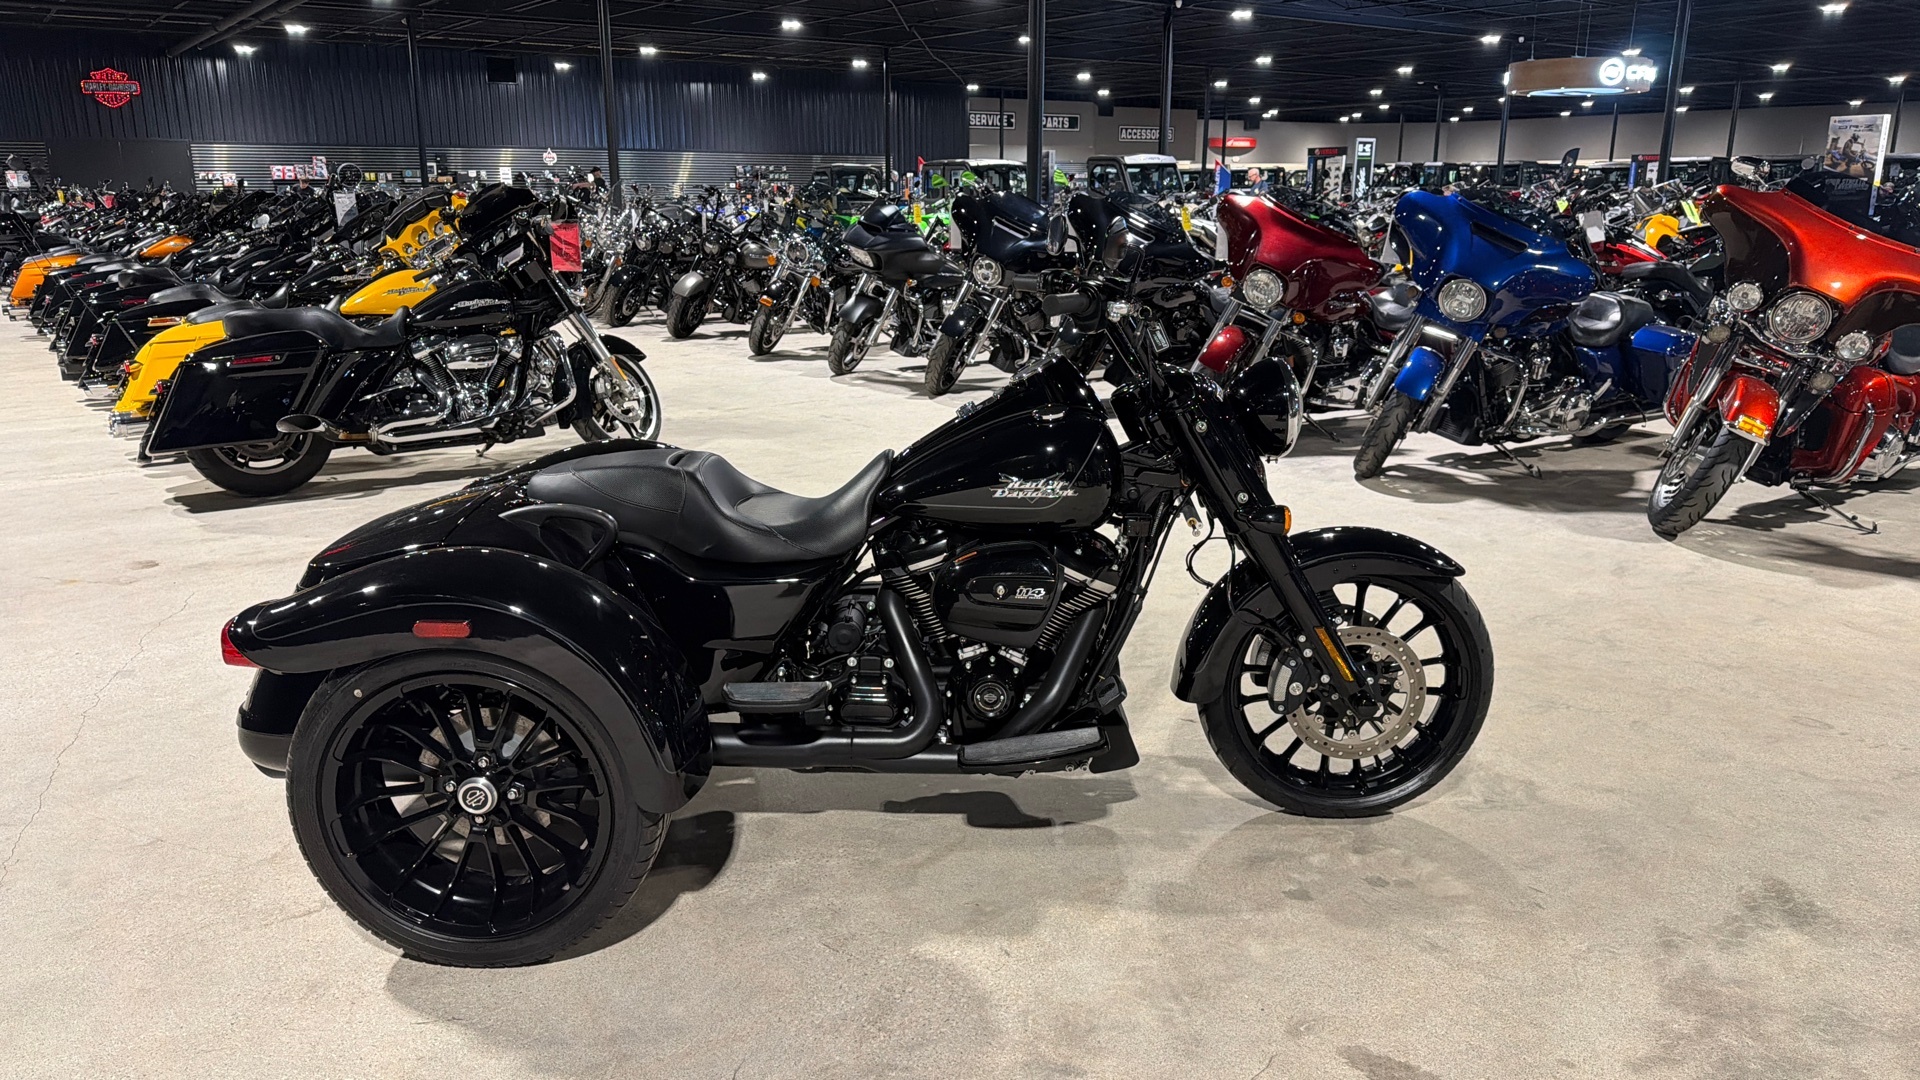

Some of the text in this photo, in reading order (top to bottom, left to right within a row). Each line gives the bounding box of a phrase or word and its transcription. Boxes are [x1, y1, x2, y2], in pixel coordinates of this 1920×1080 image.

[969, 113, 1008, 127] SERVICE
[1042, 116, 1070, 128] PARTS
[1120, 129, 1172, 140] ACCESSORS
[1005, 478, 1069, 489] Harley
[989, 487, 1079, 499] Davidson
[1016, 588, 1046, 598] 114
